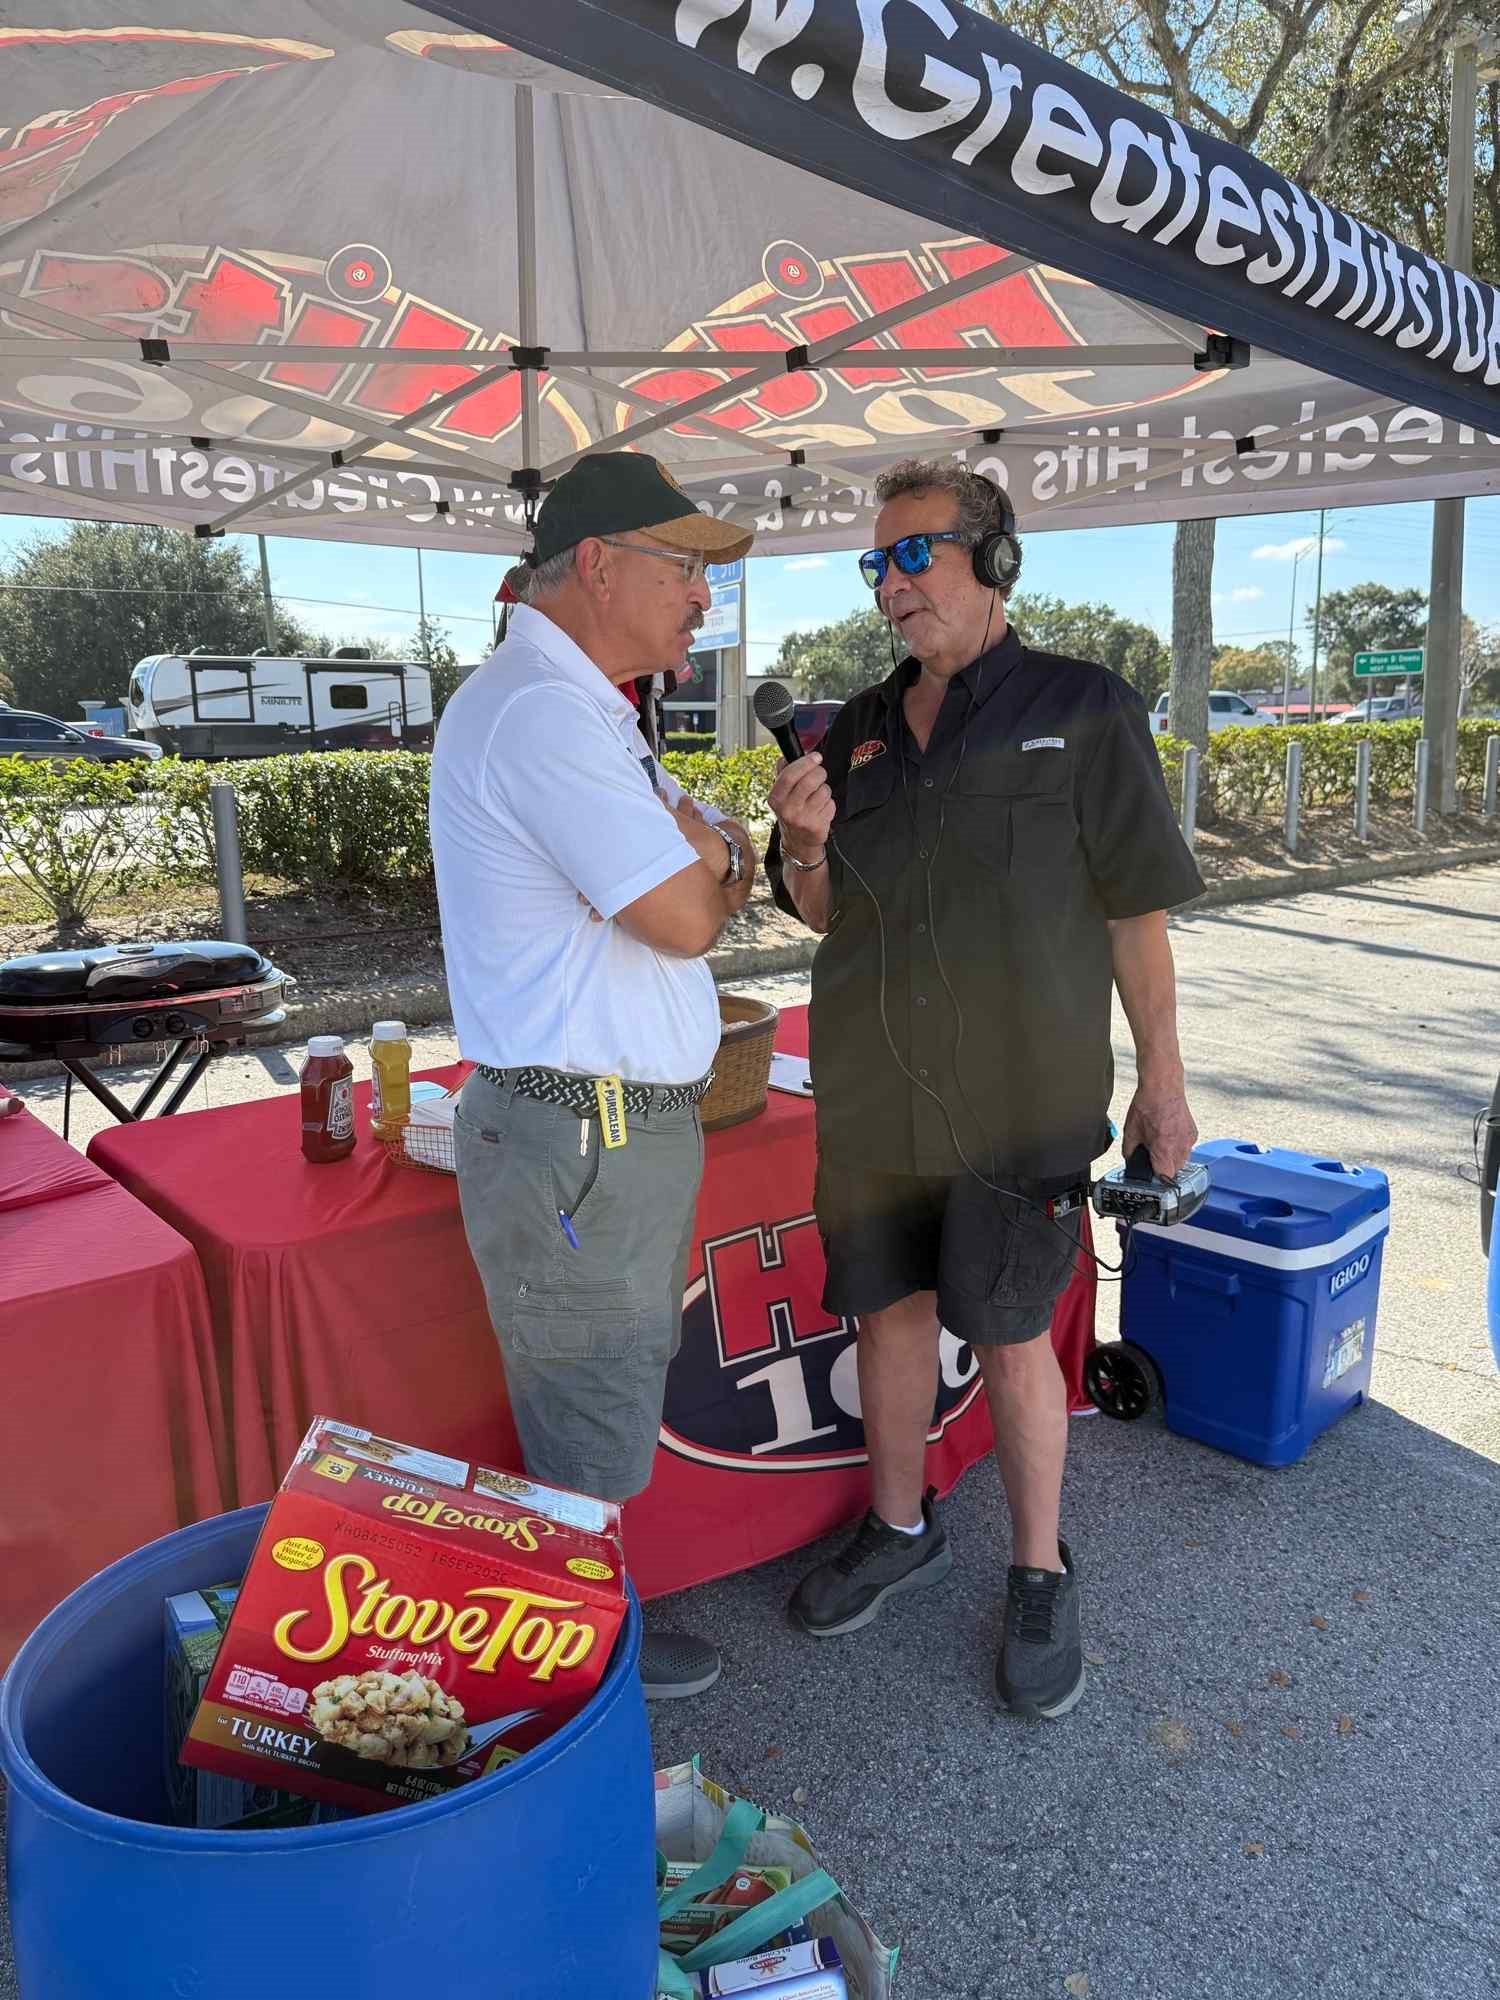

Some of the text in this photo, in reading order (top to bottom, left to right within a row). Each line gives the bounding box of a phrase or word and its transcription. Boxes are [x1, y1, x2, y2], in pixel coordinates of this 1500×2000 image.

[605, 1087, 622, 1143] PUROCLEAN
[1330, 1253, 1369, 1295] IGLOO
[363, 1470, 425, 1495] TURKEY
[231, 1717, 318, 1757] TURKEY
